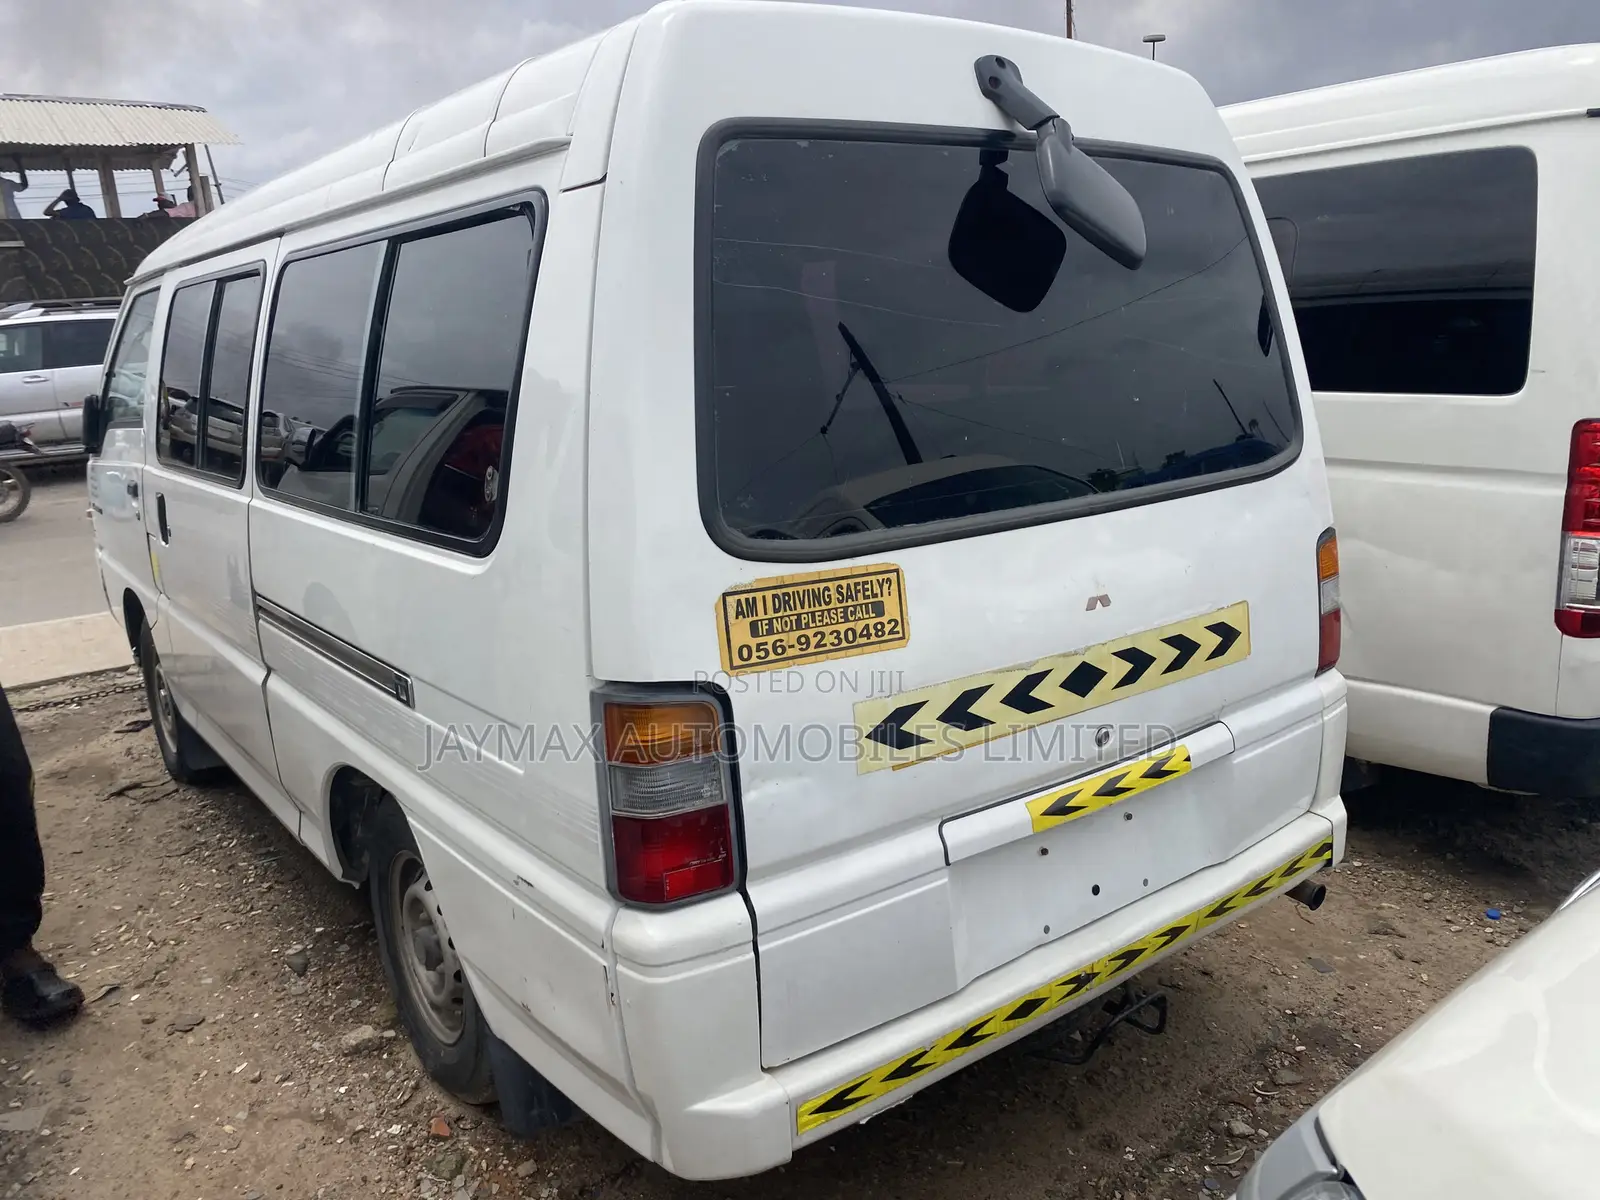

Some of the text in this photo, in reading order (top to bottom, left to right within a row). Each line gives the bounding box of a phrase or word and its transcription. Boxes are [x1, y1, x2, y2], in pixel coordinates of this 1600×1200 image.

[735, 577, 893, 620] AM I DRIVING SAFELY?
[757, 604, 876, 636] IF NOT PLEASE CALL
[737, 618, 901, 662] 056-9230482
